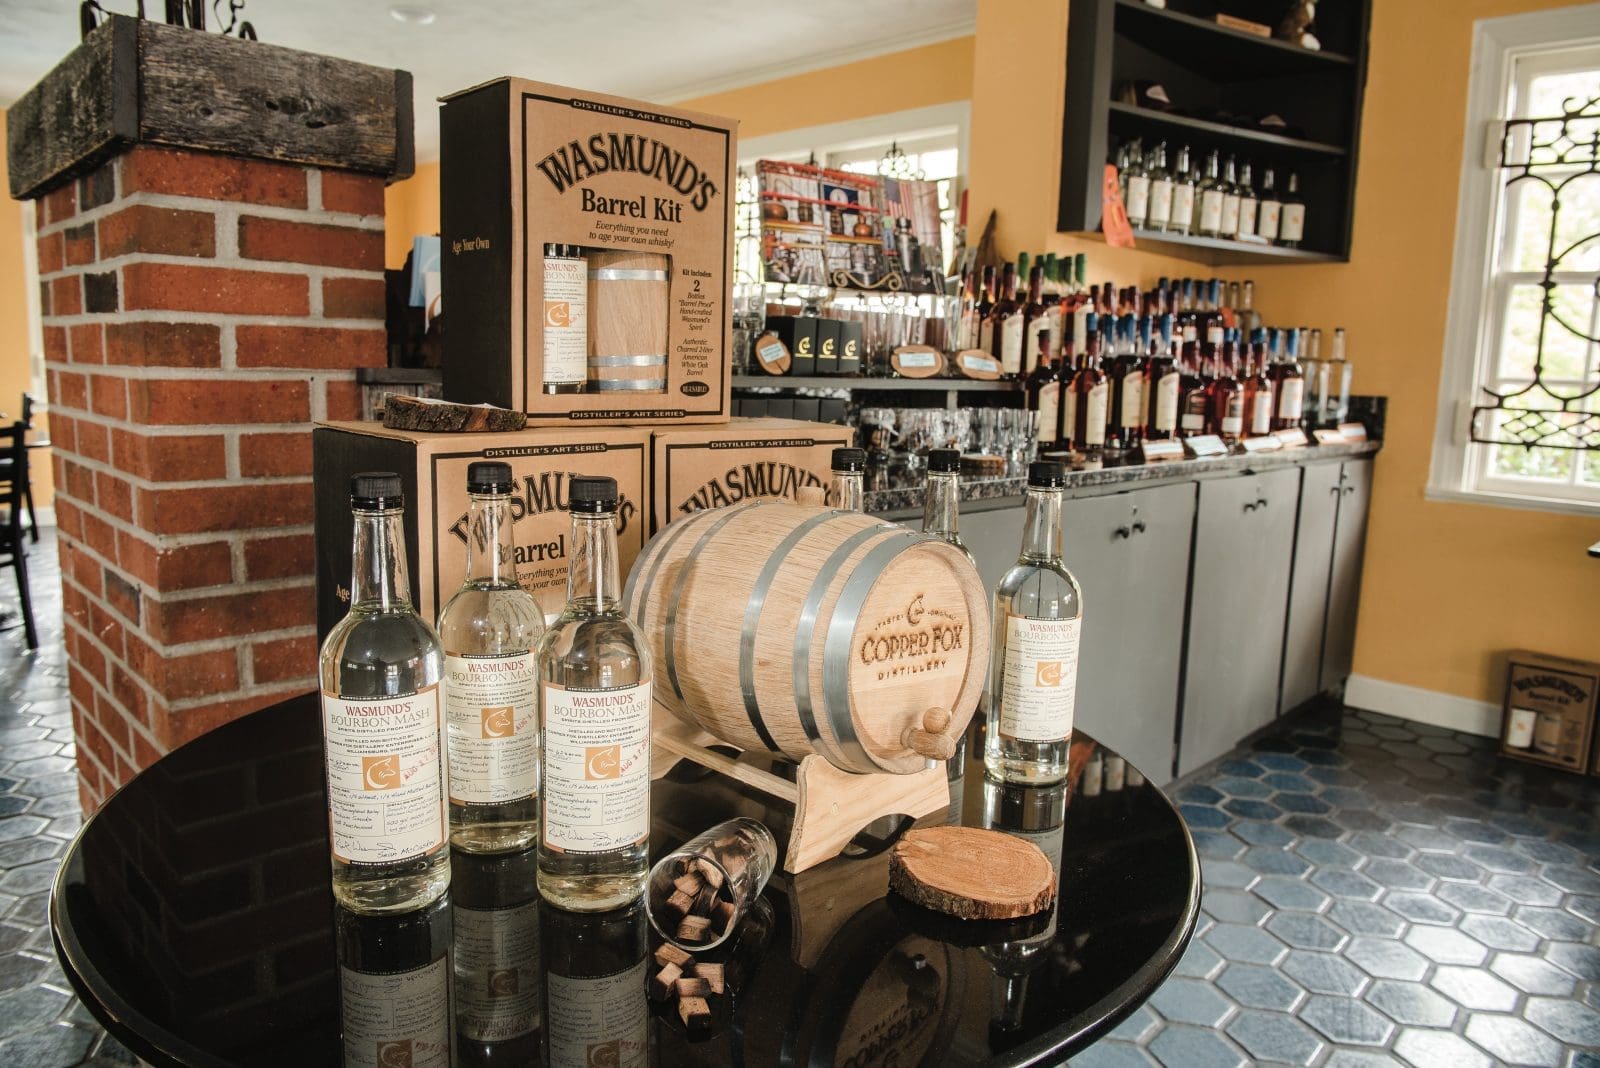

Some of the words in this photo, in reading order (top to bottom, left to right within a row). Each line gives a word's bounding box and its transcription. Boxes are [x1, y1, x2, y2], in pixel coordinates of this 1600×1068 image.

[573, 100, 634, 118] DISTILLER'S
[636, 112, 656, 120] ART
[658, 116, 690, 128] SERIES
[535, 132, 718, 213] WASMUND'S
[582, 188, 646, 219] Barrel
[654, 198, 682, 223] Kit
[596, 220, 634, 235] Everything
[636, 226, 650, 236] you
[651, 228, 669, 236] need
[589, 231, 597, 239] to
[598, 233, 612, 243] age
[612, 235, 630, 244] your
[631, 236, 646, 245] own
[648, 238, 675, 248] whisky!
[693, 279, 700, 292] 2
[486, 448, 550, 457] DISTILLER'S
[552, 446, 571, 454] ART
[574, 444, 606, 453] SERIES
[711, 440, 764, 448] DISTILLER'S
[553, 580, 570, 589] own
[336, 584, 350, 602] Age
[860, 632, 929, 666] COPPER
[932, 622, 963, 654] FOX
[468, 660, 524, 673] WASMUND'S
[878, 660, 946, 680] DISTILLERY
[452, 672, 507, 683] BOURBON
[572, 694, 633, 708] WASMUND'S
[345, 703, 411, 716] WASMUND'S
[554, 705, 615, 718] BOURBON
[331, 714, 390, 727] BOURBON
[394, 708, 430, 725] MASH
